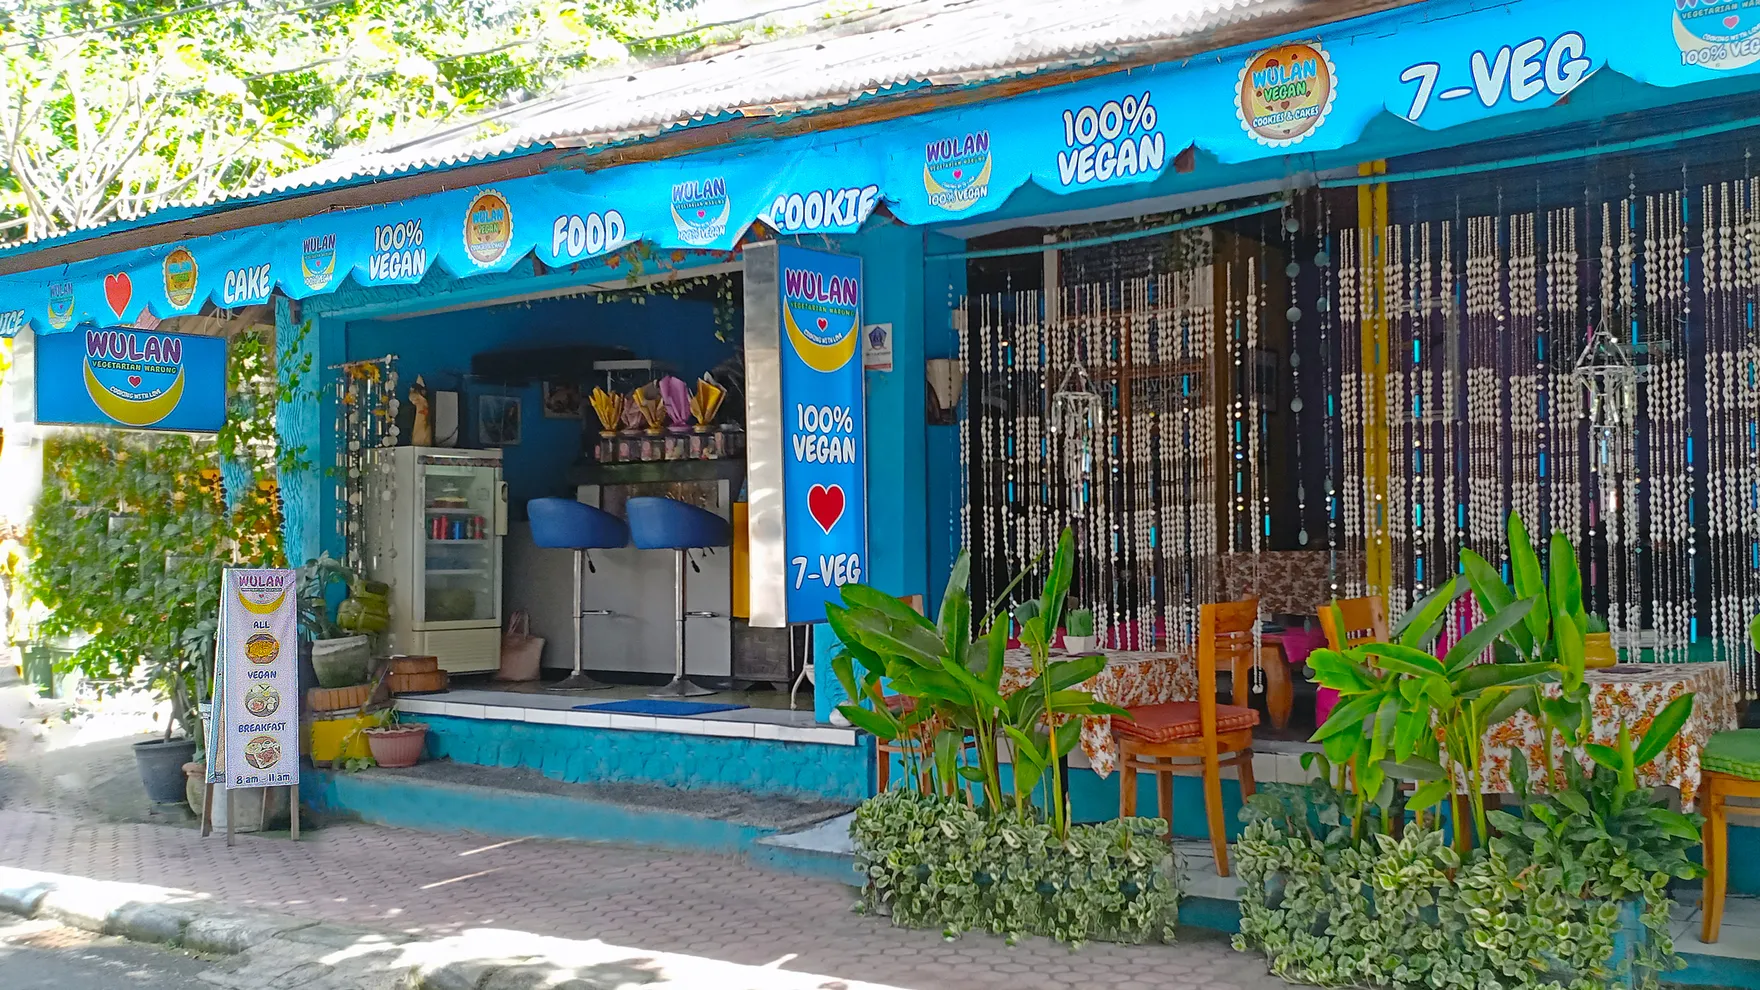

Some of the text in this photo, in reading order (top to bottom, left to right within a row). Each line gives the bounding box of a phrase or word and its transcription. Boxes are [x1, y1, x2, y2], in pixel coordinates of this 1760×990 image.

[1681, 3, 1738, 19] VEGETARIAN
[1681, 44, 1728, 67] 100%
[1252, 58, 1317, 90] WULAN
[1400, 31, 1593, 121] 7-VEG
[1264, 80, 1307, 103] VEGAN
[1062, 90, 1158, 147] 100%
[1252, 112, 1285, 128] COOKIES
[1294, 104, 1320, 120] CAKES
[925, 130, 990, 164] WULAN
[1058, 131, 1166, 186] VEGAN
[672, 176, 726, 203] WULAN
[928, 190, 955, 206] 100%
[302, 232, 337, 254] WULAN
[374, 218, 424, 252] 100%
[552, 209, 626, 259] FOOD
[369, 247, 427, 282] VEGAN
[223, 263, 271, 305] CAKE
[786, 267, 858, 307] WULAN
[789, 302, 827, 313] VEGETARIAN
[86, 330, 183, 364] WULAN
[92, 360, 178, 374] VEGETARIAN WARUNG
[797, 403, 853, 433] 100%
[792, 433, 856, 464] VEGAN
[239, 575, 284, 587] WULAN
[791, 552, 862, 590] 7-VEG
[253, 621, 270, 629] ALL
[247, 670, 277, 679] VEGAN
[238, 722, 286, 733] BREAKFAST
[236, 775, 243, 785] 8
[245, 776, 259, 784] am
[277, 774, 290, 782] am
